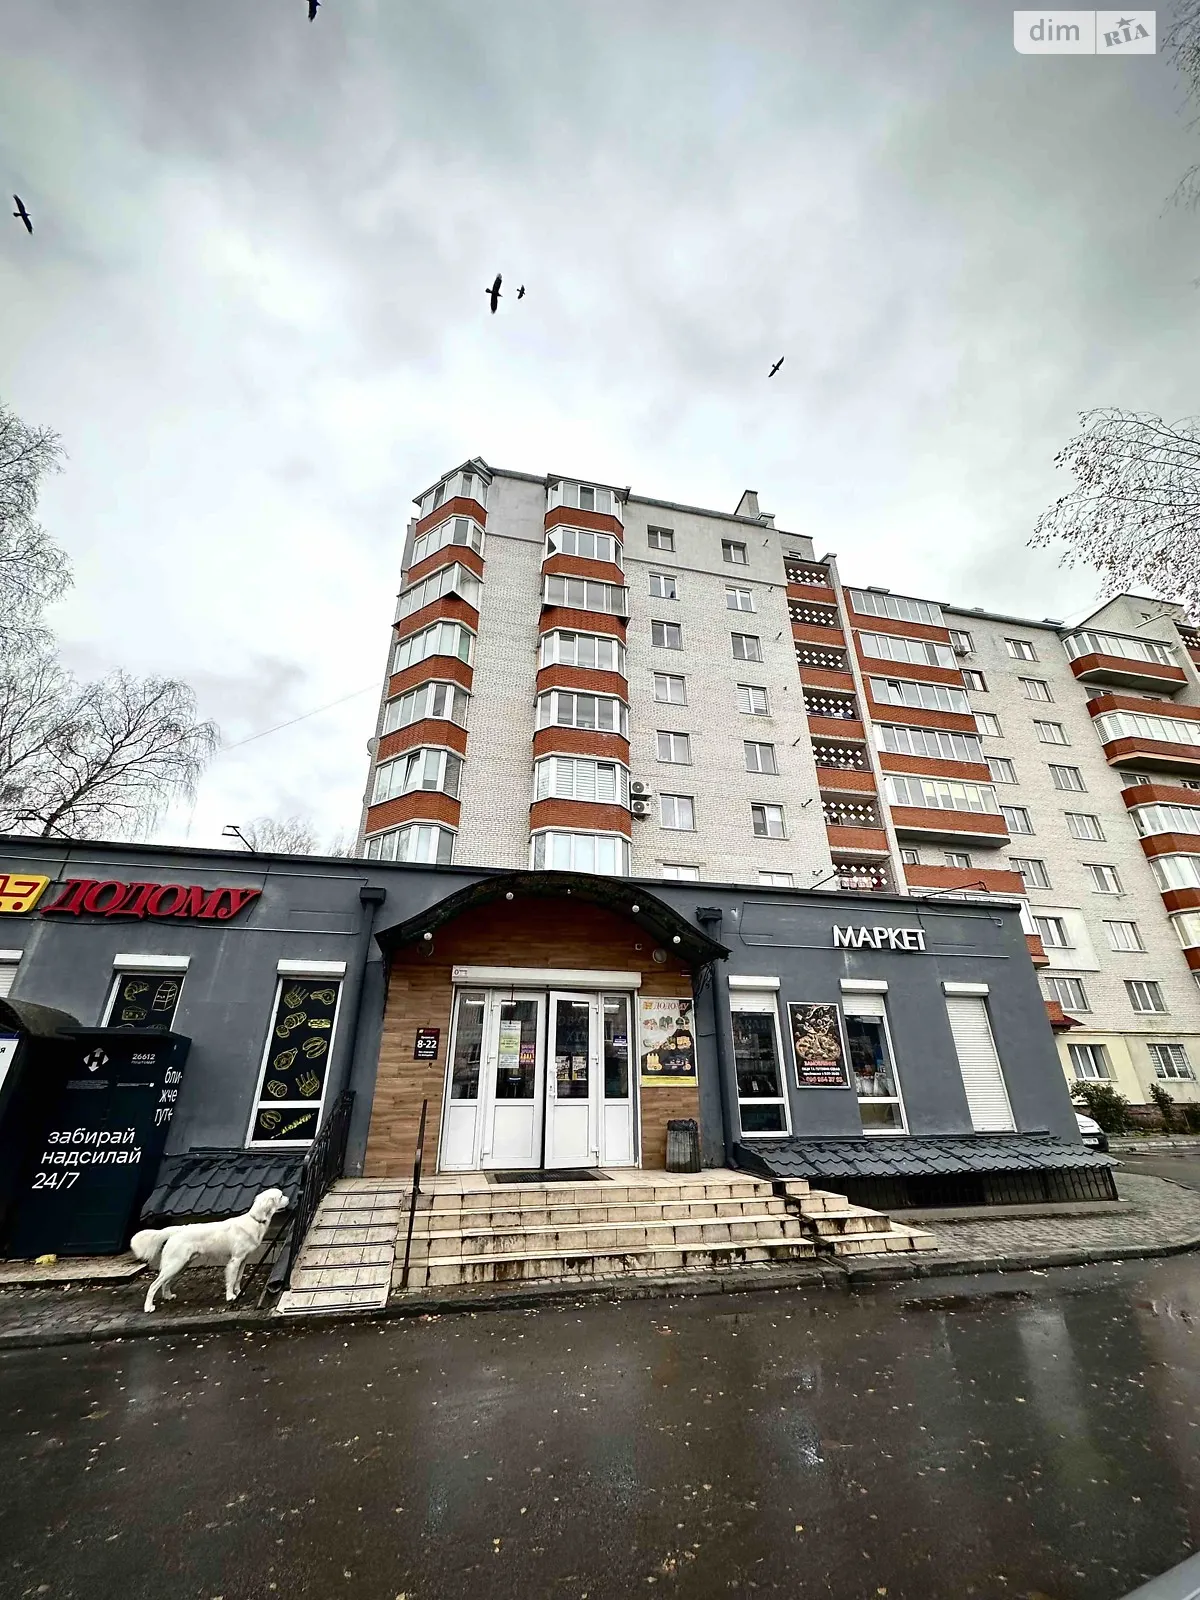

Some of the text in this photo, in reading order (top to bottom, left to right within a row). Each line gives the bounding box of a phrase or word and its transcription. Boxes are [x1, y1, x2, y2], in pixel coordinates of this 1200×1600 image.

[40, 878, 262, 920] ДОДОМУ
[832, 924, 926, 951] МАРКЕТ
[417, 1039, 437, 1049] 8-22
[158, 1089, 178, 1103] жче
[47, 1127, 135, 1148] забирай
[41, 1146, 142, 1167] надсилай
[31, 1171, 80, 1190] 24/7
